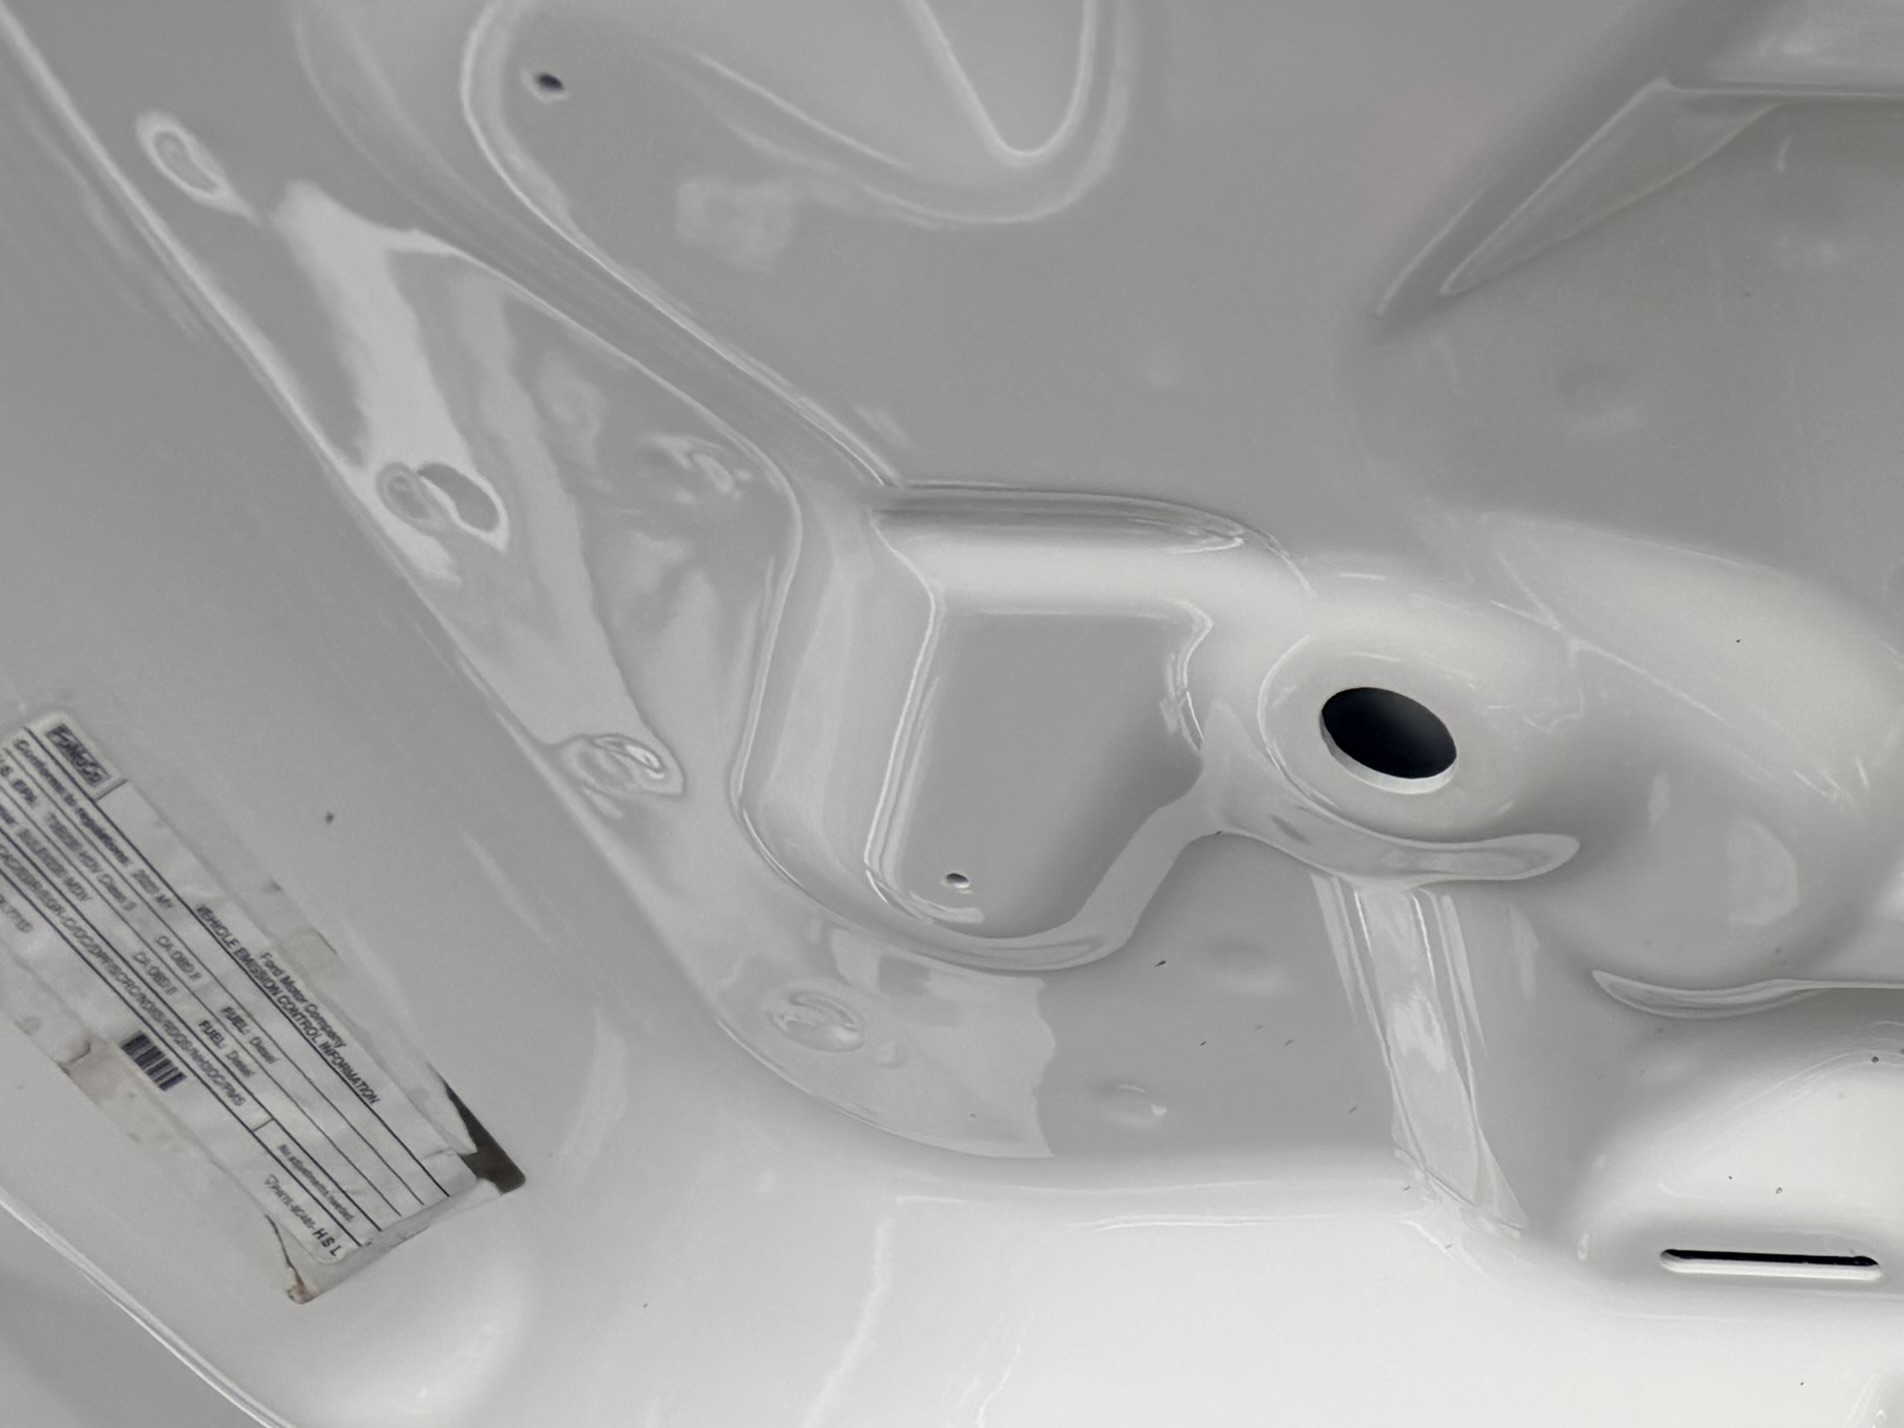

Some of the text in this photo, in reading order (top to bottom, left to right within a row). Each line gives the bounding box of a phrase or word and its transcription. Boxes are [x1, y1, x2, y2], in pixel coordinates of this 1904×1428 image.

[232, 945, 282, 998] EMISSION
[275, 993, 323, 1043] CONTROL
[258, 951, 285, 978] Ford
[301, 1001, 349, 1051] Company
